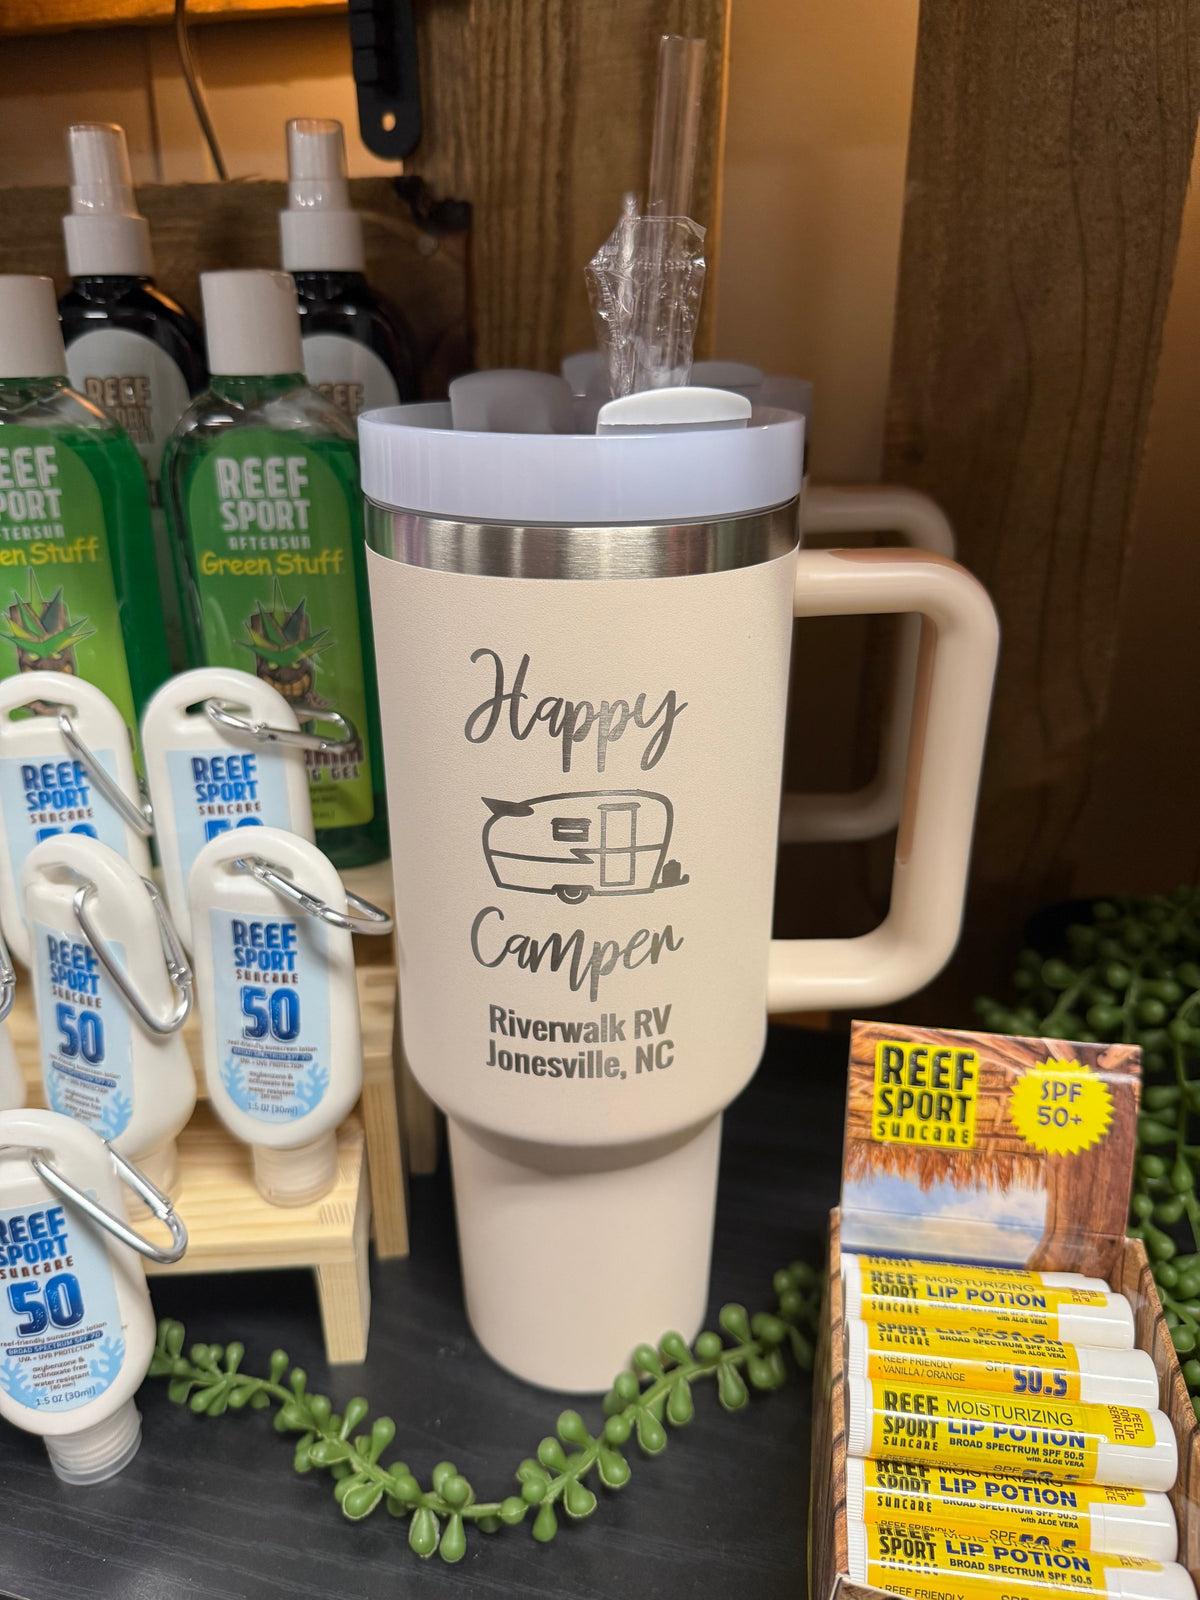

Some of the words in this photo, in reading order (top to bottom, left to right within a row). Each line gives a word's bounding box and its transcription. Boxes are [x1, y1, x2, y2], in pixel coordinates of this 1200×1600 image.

[0, 446, 58, 489] EEF
[215, 456, 309, 499] REEF
[0, 488, 62, 521] PORT
[219, 499, 310, 532] SPORT
[0, 524, 65, 541] TERSUN
[228, 536, 311, 550] AFTERSUN
[30, 536, 99, 565] Stuff
[201, 551, 272, 576] Green
[276, 549, 344, 575] Stuff
[464, 648, 689, 773] Happy
[191, 754, 257, 783] REEF
[26, 786, 90, 812] SPORT
[195, 781, 258, 803] SPORT
[231, 919, 297, 950] REEF
[47, 934, 100, 972] REEF
[234, 947, 298, 971] SPORT
[471, 906, 684, 1003] Camper
[50, 962, 100, 995] SPORT
[240, 984, 301, 1042] 50
[489, 1003, 626, 1044] Riverwalk
[634, 1003, 673, 1039] RV
[56, 1002, 105, 1066] 50
[486, 1039, 627, 1080] Jonesville,
[635, 1039, 675, 1074] NC
[880, 1046, 975, 1091] REEF
[1041, 1080, 1083, 1103] SPF
[877, 1089, 971, 1125] SPORT
[1037, 1106, 1083, 1128] 50+
[925, 1275, 1035, 1292] MOISTURIZING
[927, 1285, 958, 1299] LIP
[966, 1288, 1047, 1308] POTION
[7, 1272, 85, 1337] 50
[884, 1365, 920, 1377] VANILLA
[926, 1369, 966, 1382] ORANGE
[910, 1357, 954, 1370] FRIENDLY
[1013, 1363, 1068, 1397] 50.5
[884, 1390, 939, 1416] REEF
[947, 1399, 1074, 1426] MOISTURIZING
[883, 1415, 939, 1440] SPORT
[948, 1416, 985, 1436] LIP
[993, 1421, 1085, 1448] POTION
[949, 1437, 983, 1448] BROAD
[986, 1442, 1039, 1455] SPECTRUM
[1042, 1449, 1061, 1458] SPF
[1064, 1451, 1084, 1461] 50.5
[1065, 1460, 1085, 1468] VERA
[877, 1474, 932, 1498] SPORT
[940, 1476, 977, 1494] LIP
[984, 1482, 1077, 1508] POTION
[990, 1530, 1017, 1543] SPF
[1020, 1516, 1036, 1524] with
[1038, 1518, 1057, 1526] ALOE
[1059, 1520, 1079, 1529] VERA
[880, 1536, 936, 1561] SPORT
[945, 1540, 984, 1557] LIP
[992, 1546, 1091, 1572] POTION
[950, 1558, 985, 1570] BROAD
[988, 1563, 1045, 1578] SPECTRUM
[1048, 1571, 1067, 1582] SPF
[1071, 1574, 1092, 1585] 50.5
